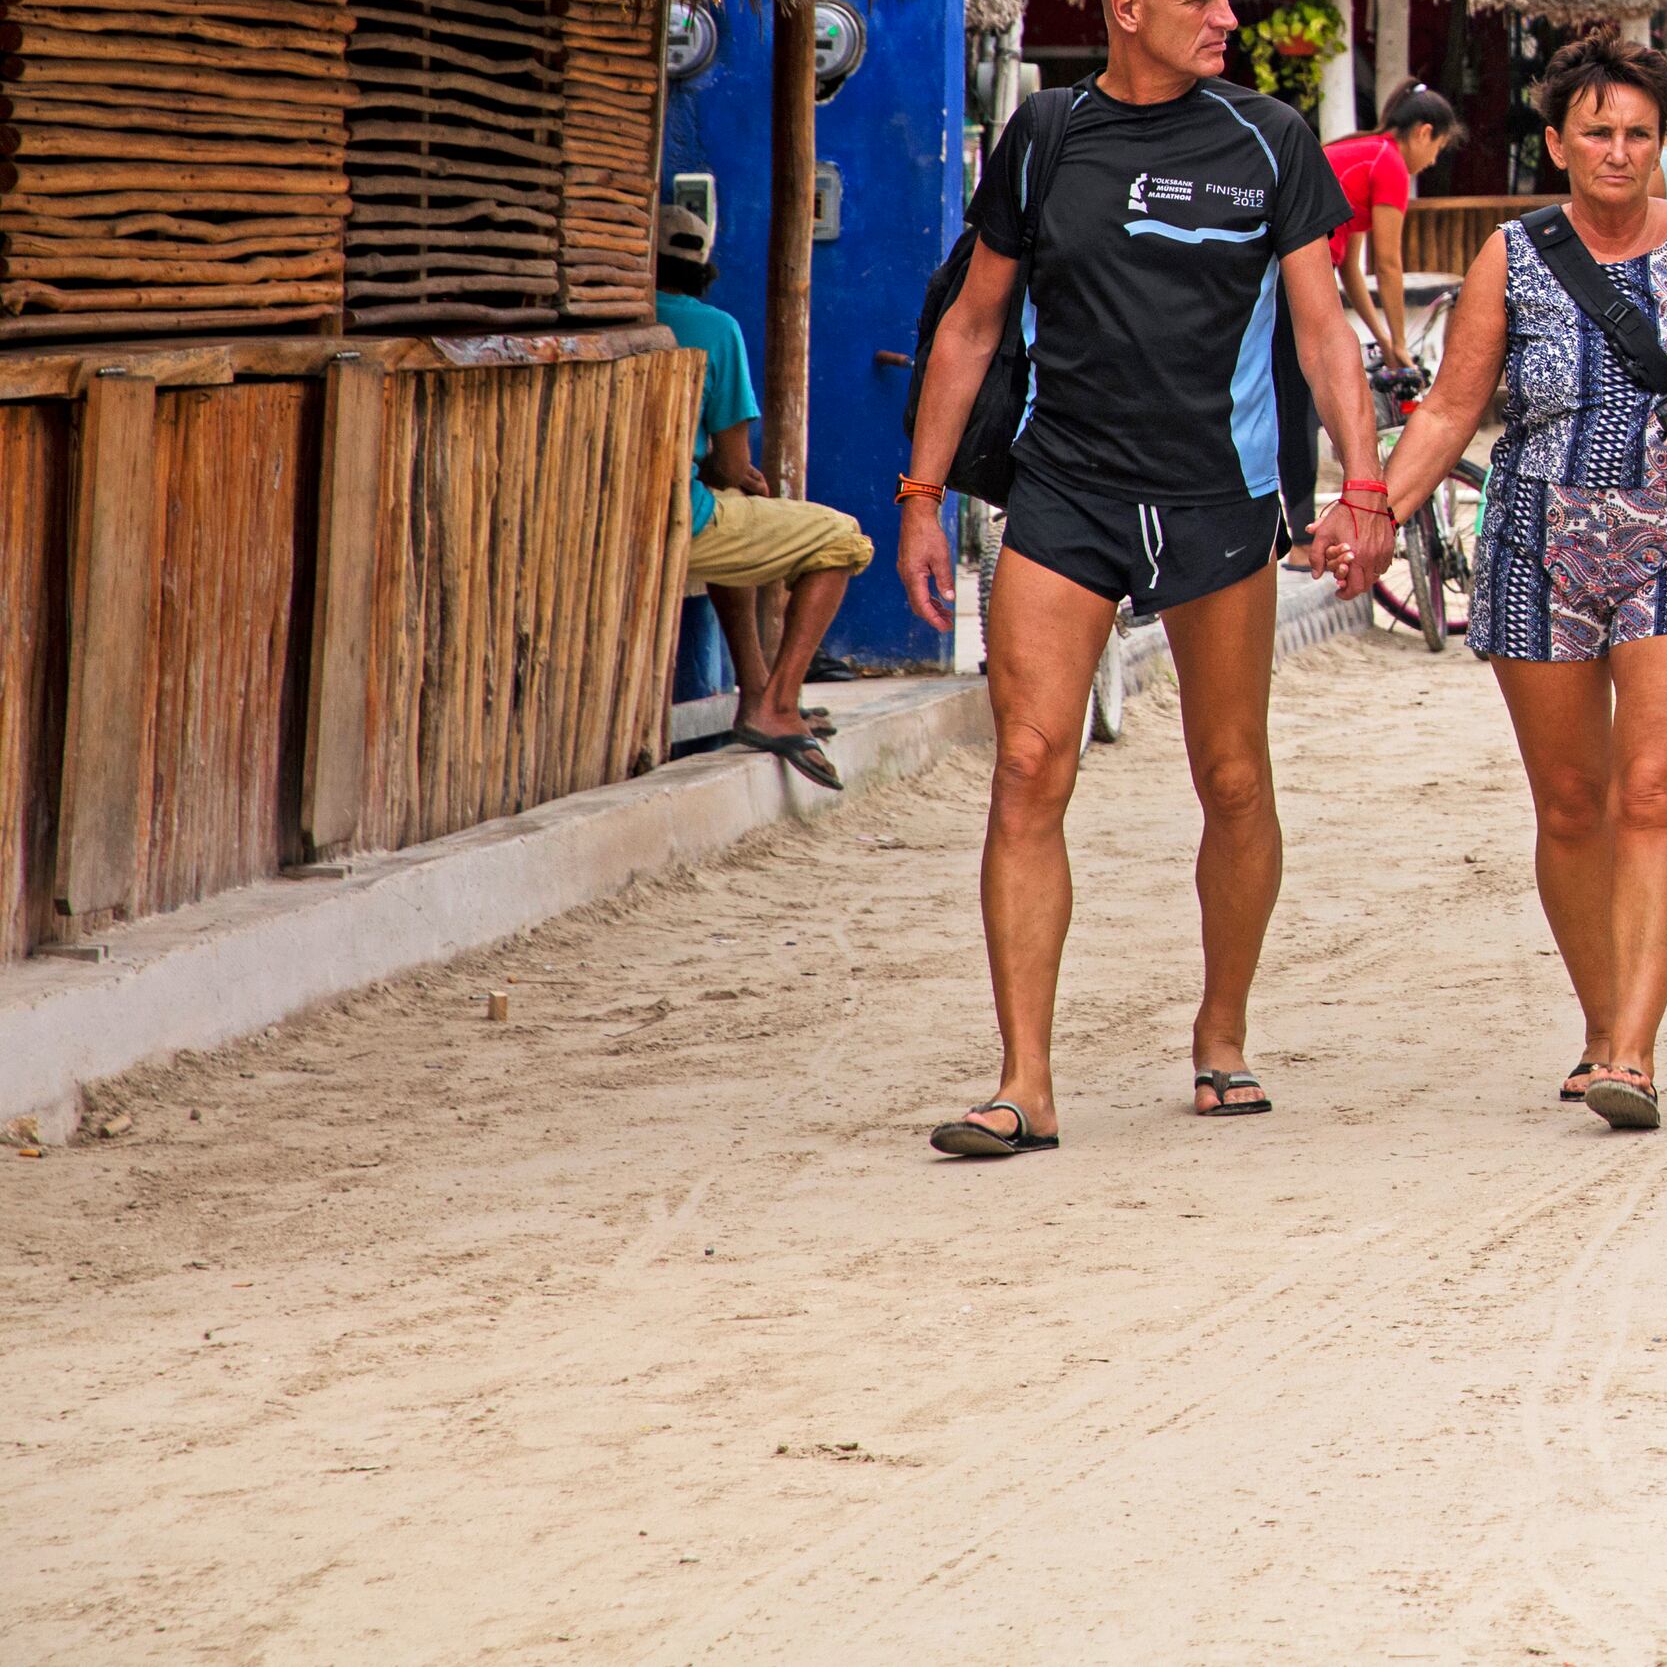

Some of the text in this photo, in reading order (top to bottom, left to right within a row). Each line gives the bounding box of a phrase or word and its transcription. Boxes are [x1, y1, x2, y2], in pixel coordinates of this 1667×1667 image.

[1151, 177, 1193, 187] VOLKSBANK
[1156, 184, 1192, 194] MÜNSTER
[1206, 183, 1264, 198] FINISHER
[1147, 191, 1191, 202] MARATHON
[1232, 196, 1263, 208] 2012
